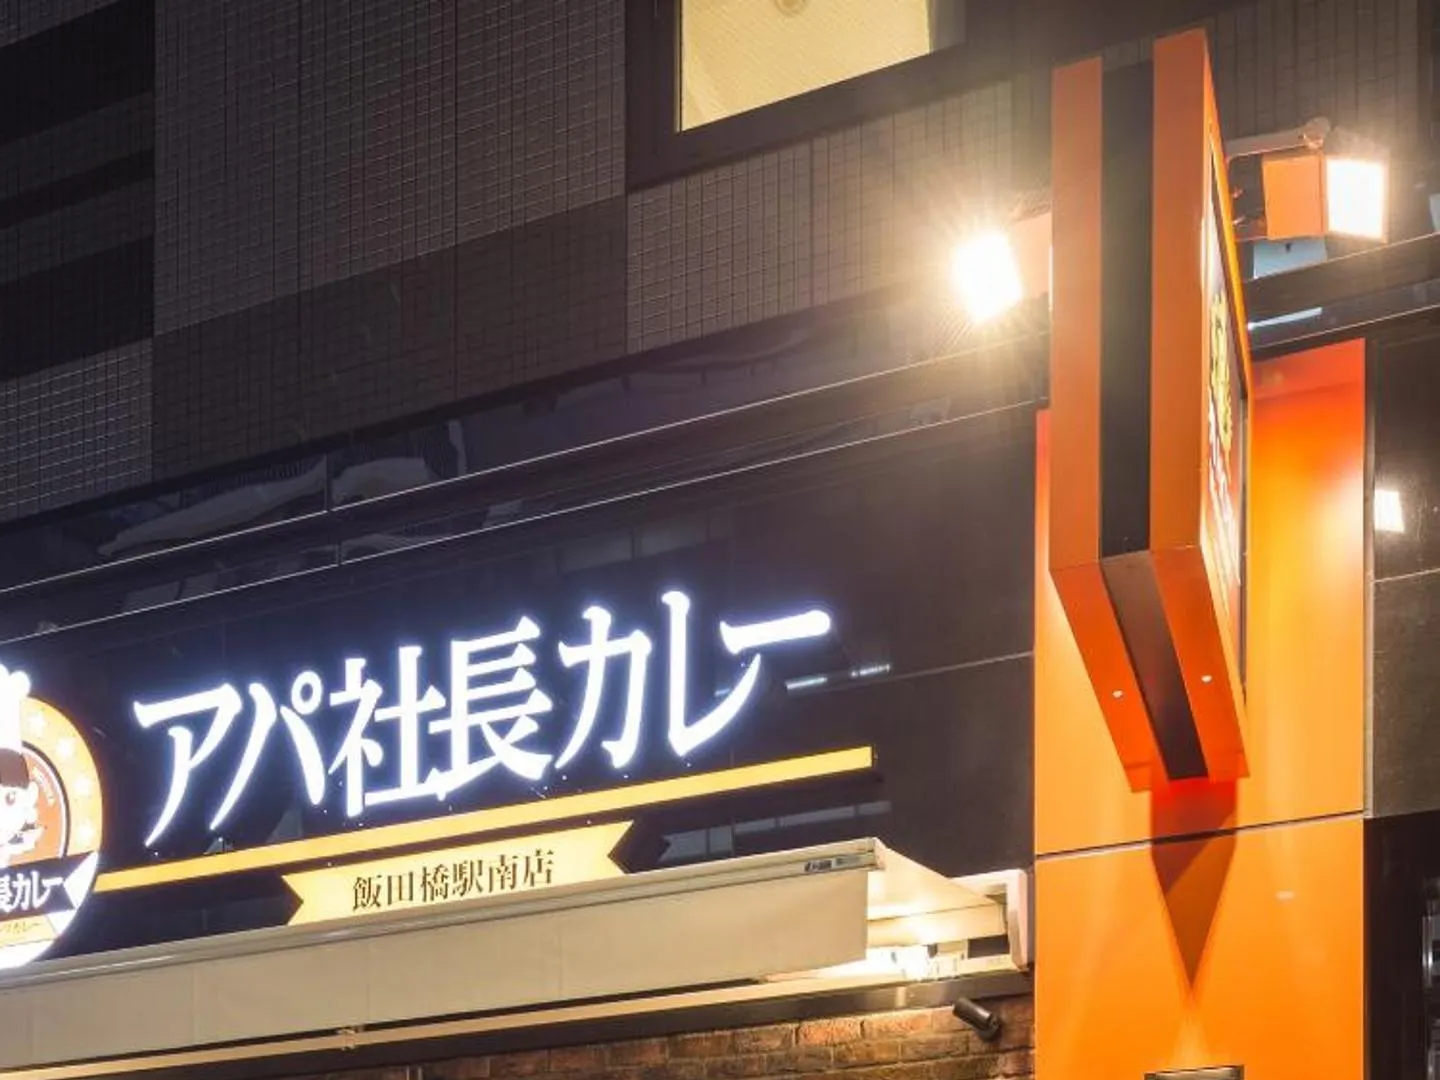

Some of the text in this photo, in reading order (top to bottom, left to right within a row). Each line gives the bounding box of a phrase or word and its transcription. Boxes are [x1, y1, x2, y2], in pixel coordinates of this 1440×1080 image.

[133, 590, 831, 848] アパ社長カレー
[352, 848, 555, 912] 飯田橋駅南店
